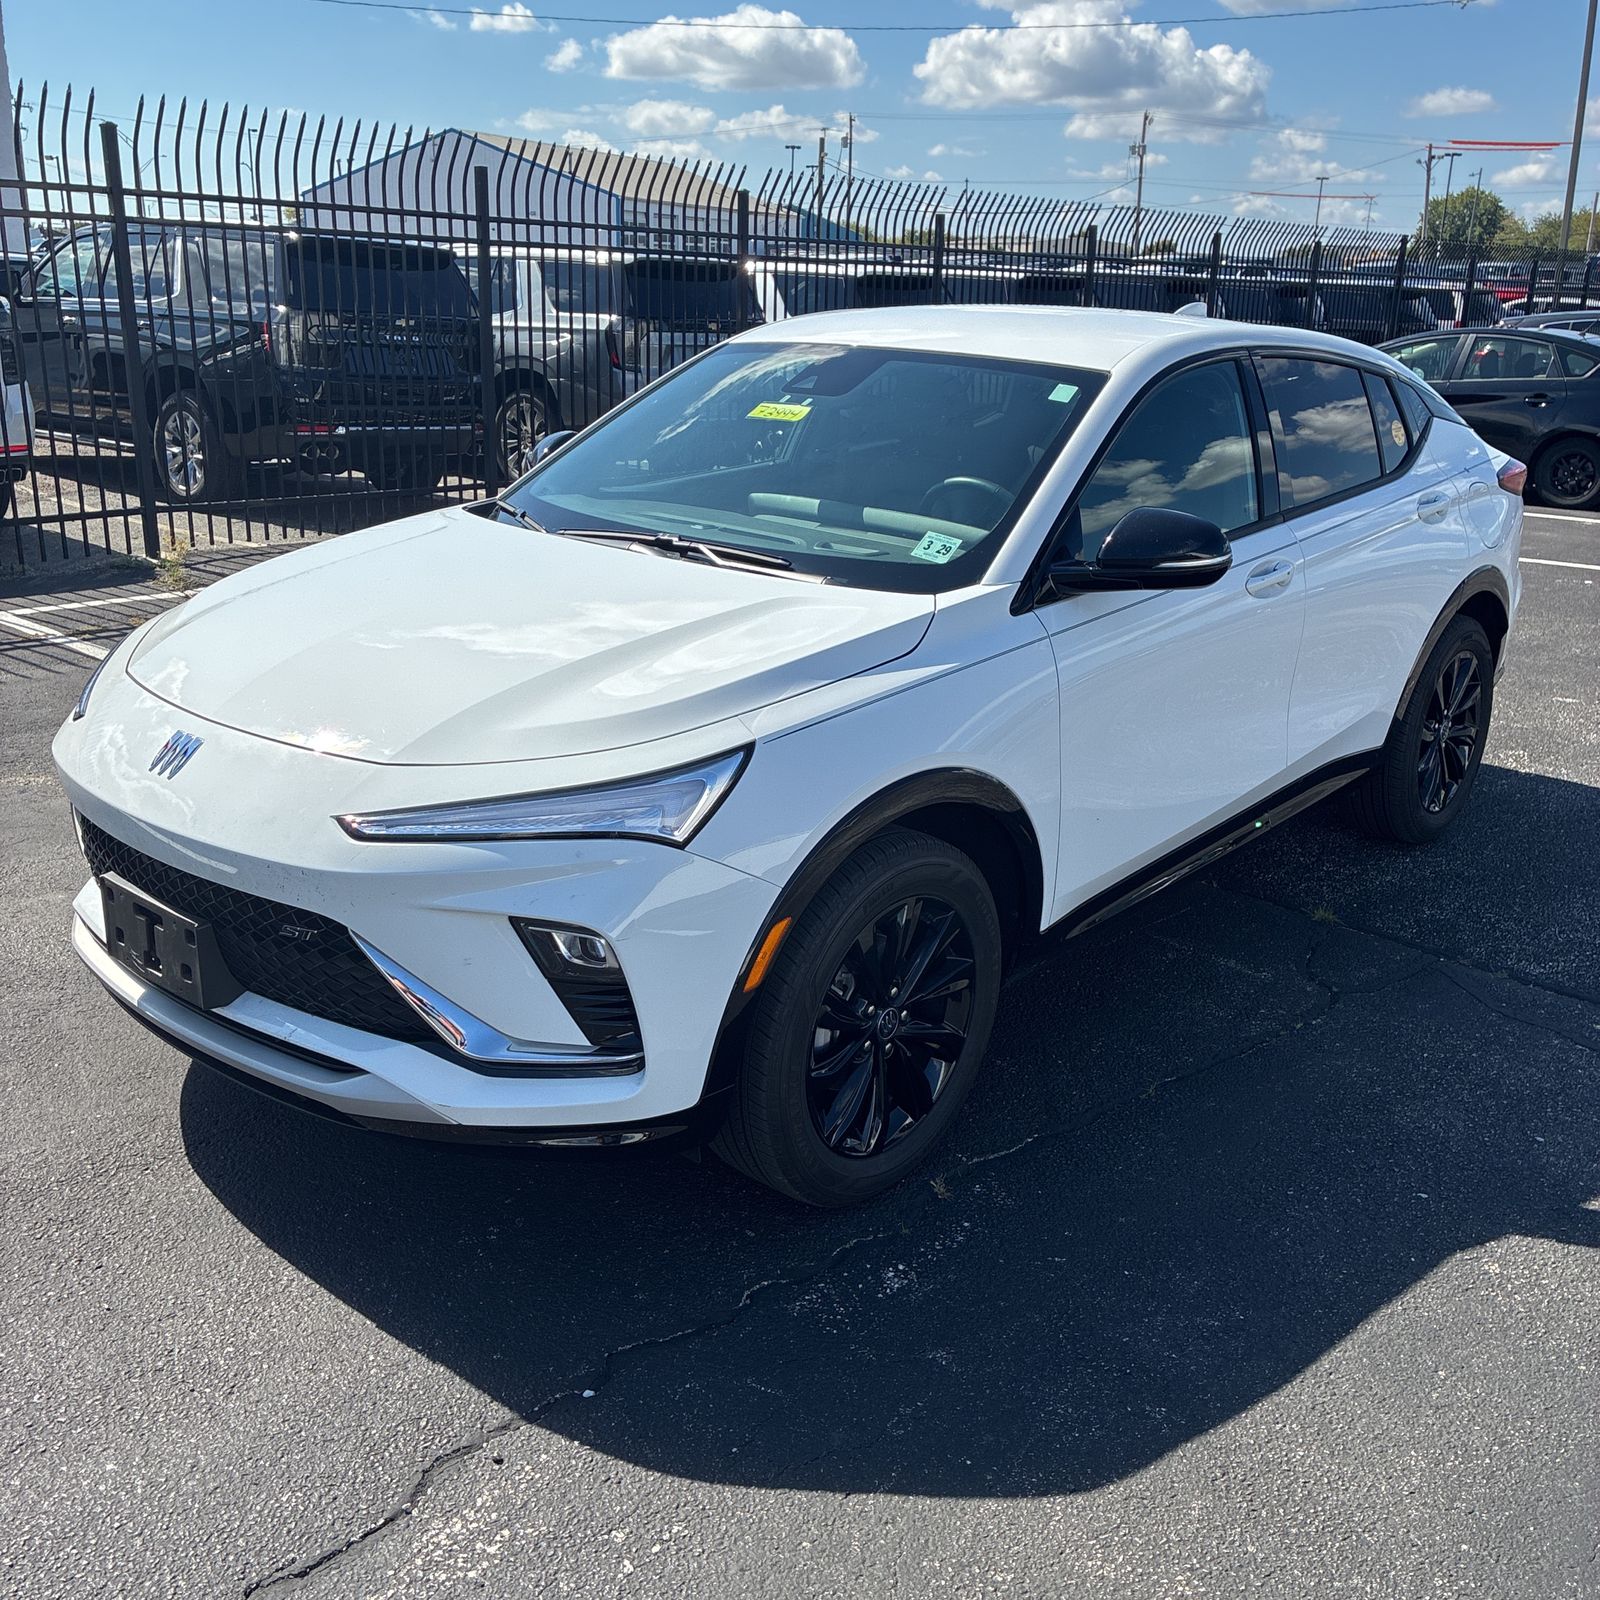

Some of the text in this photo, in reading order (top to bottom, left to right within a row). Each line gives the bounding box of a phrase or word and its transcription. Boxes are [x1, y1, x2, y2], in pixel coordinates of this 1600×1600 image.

[384, 334, 425, 342] TAO
[923, 540, 934, 551] 3
[935, 544, 953, 556] 29
[279, 925, 318, 941] ST
